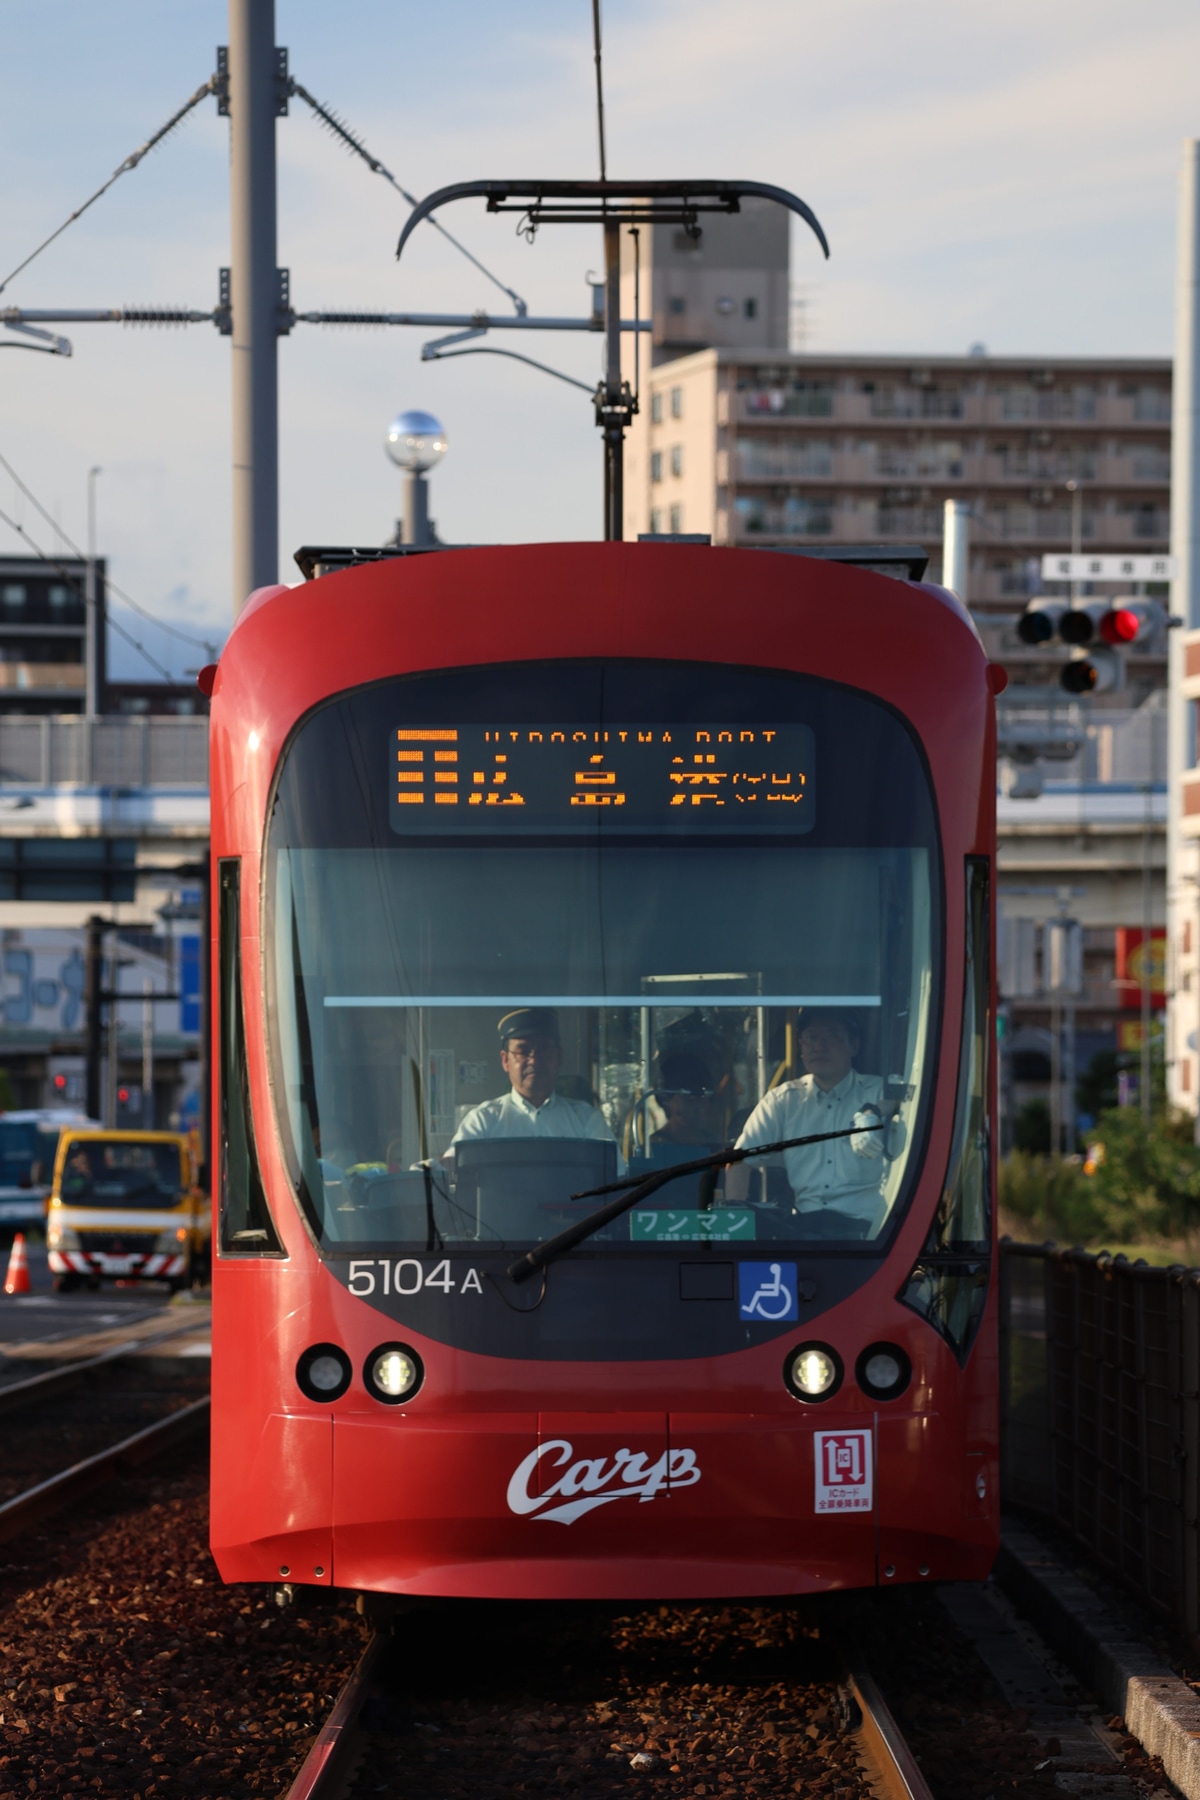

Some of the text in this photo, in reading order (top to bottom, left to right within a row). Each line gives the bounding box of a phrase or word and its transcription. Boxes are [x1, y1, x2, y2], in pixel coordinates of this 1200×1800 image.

[637, 1212, 748, 1232] ワンマン
[839, 1453, 848, 1462] IC
[507, 1439, 702, 1526] Carp
[829, 1488, 859, 1497] ICカード
